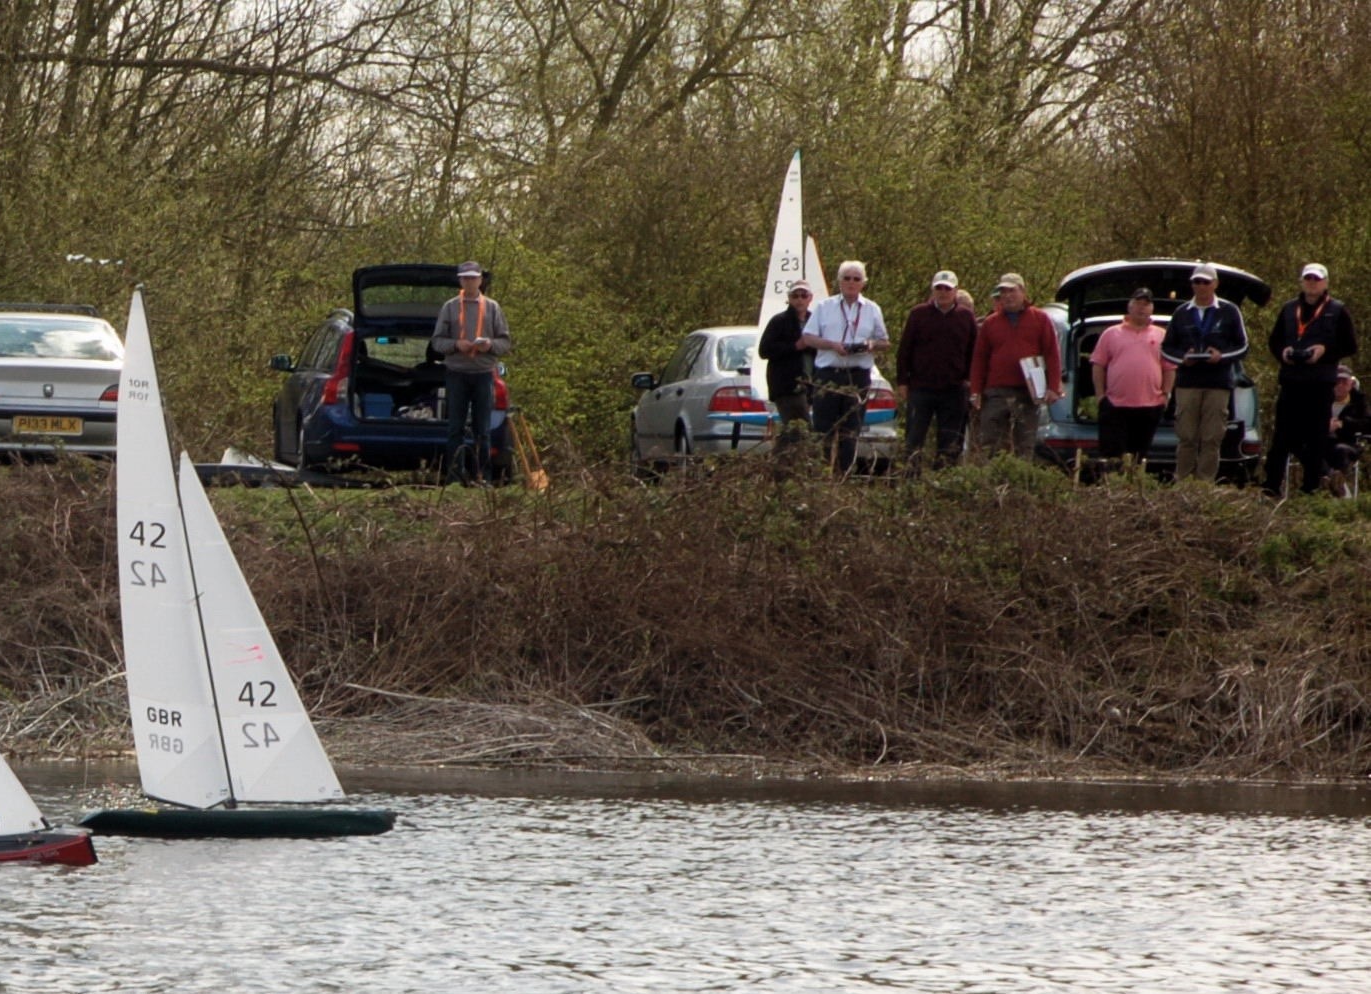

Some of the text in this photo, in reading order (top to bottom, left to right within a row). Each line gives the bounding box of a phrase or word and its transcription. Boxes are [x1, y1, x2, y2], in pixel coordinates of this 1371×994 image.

[780, 257, 799, 271] 23
[129, 521, 166, 548] 42
[238, 681, 276, 707] 42
[146, 707, 181, 727] GBR
